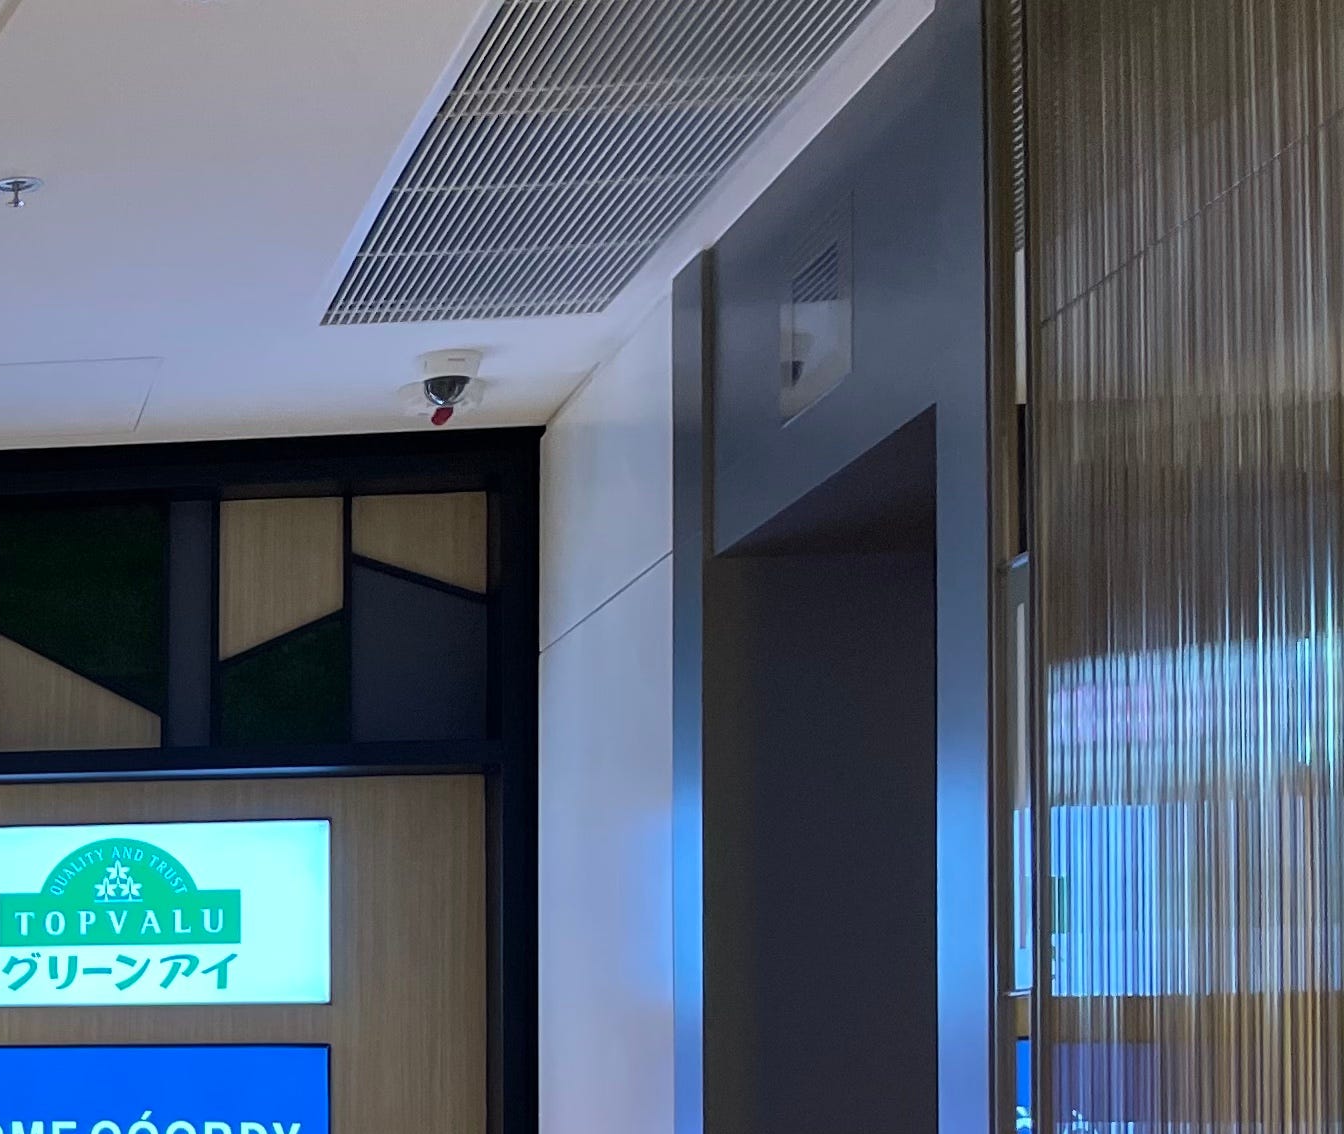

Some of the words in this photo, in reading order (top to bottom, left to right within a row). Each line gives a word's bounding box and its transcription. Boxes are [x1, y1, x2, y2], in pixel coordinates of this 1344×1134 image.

[50, 847, 105, 897] QUALITY
[112, 846, 144, 864] AND
[147, 854, 190, 897] TRUST
[14, 909, 226, 936] TOPVALU
[1, 952, 238, 991] グリーンアイ
